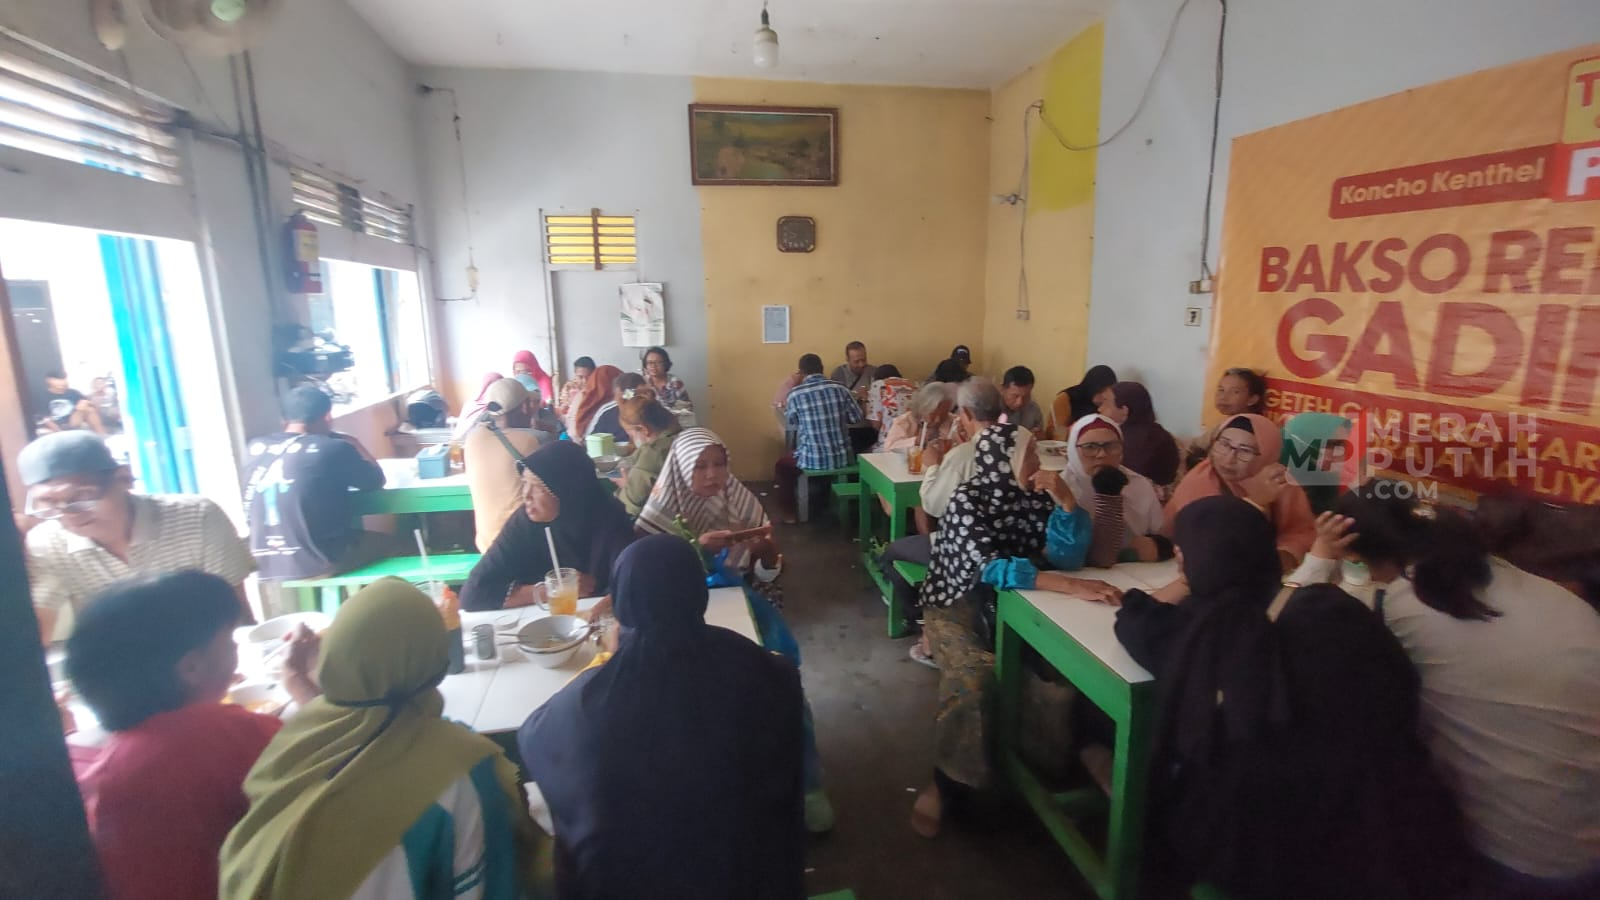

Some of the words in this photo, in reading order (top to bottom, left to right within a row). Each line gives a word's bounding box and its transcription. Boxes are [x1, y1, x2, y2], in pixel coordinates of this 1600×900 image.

[1339, 178, 1427, 205] Koncho
[1430, 157, 1546, 194] Kenthel
[1258, 233, 1471, 295] BAKSO
[1481, 226, 1600, 295] RE
